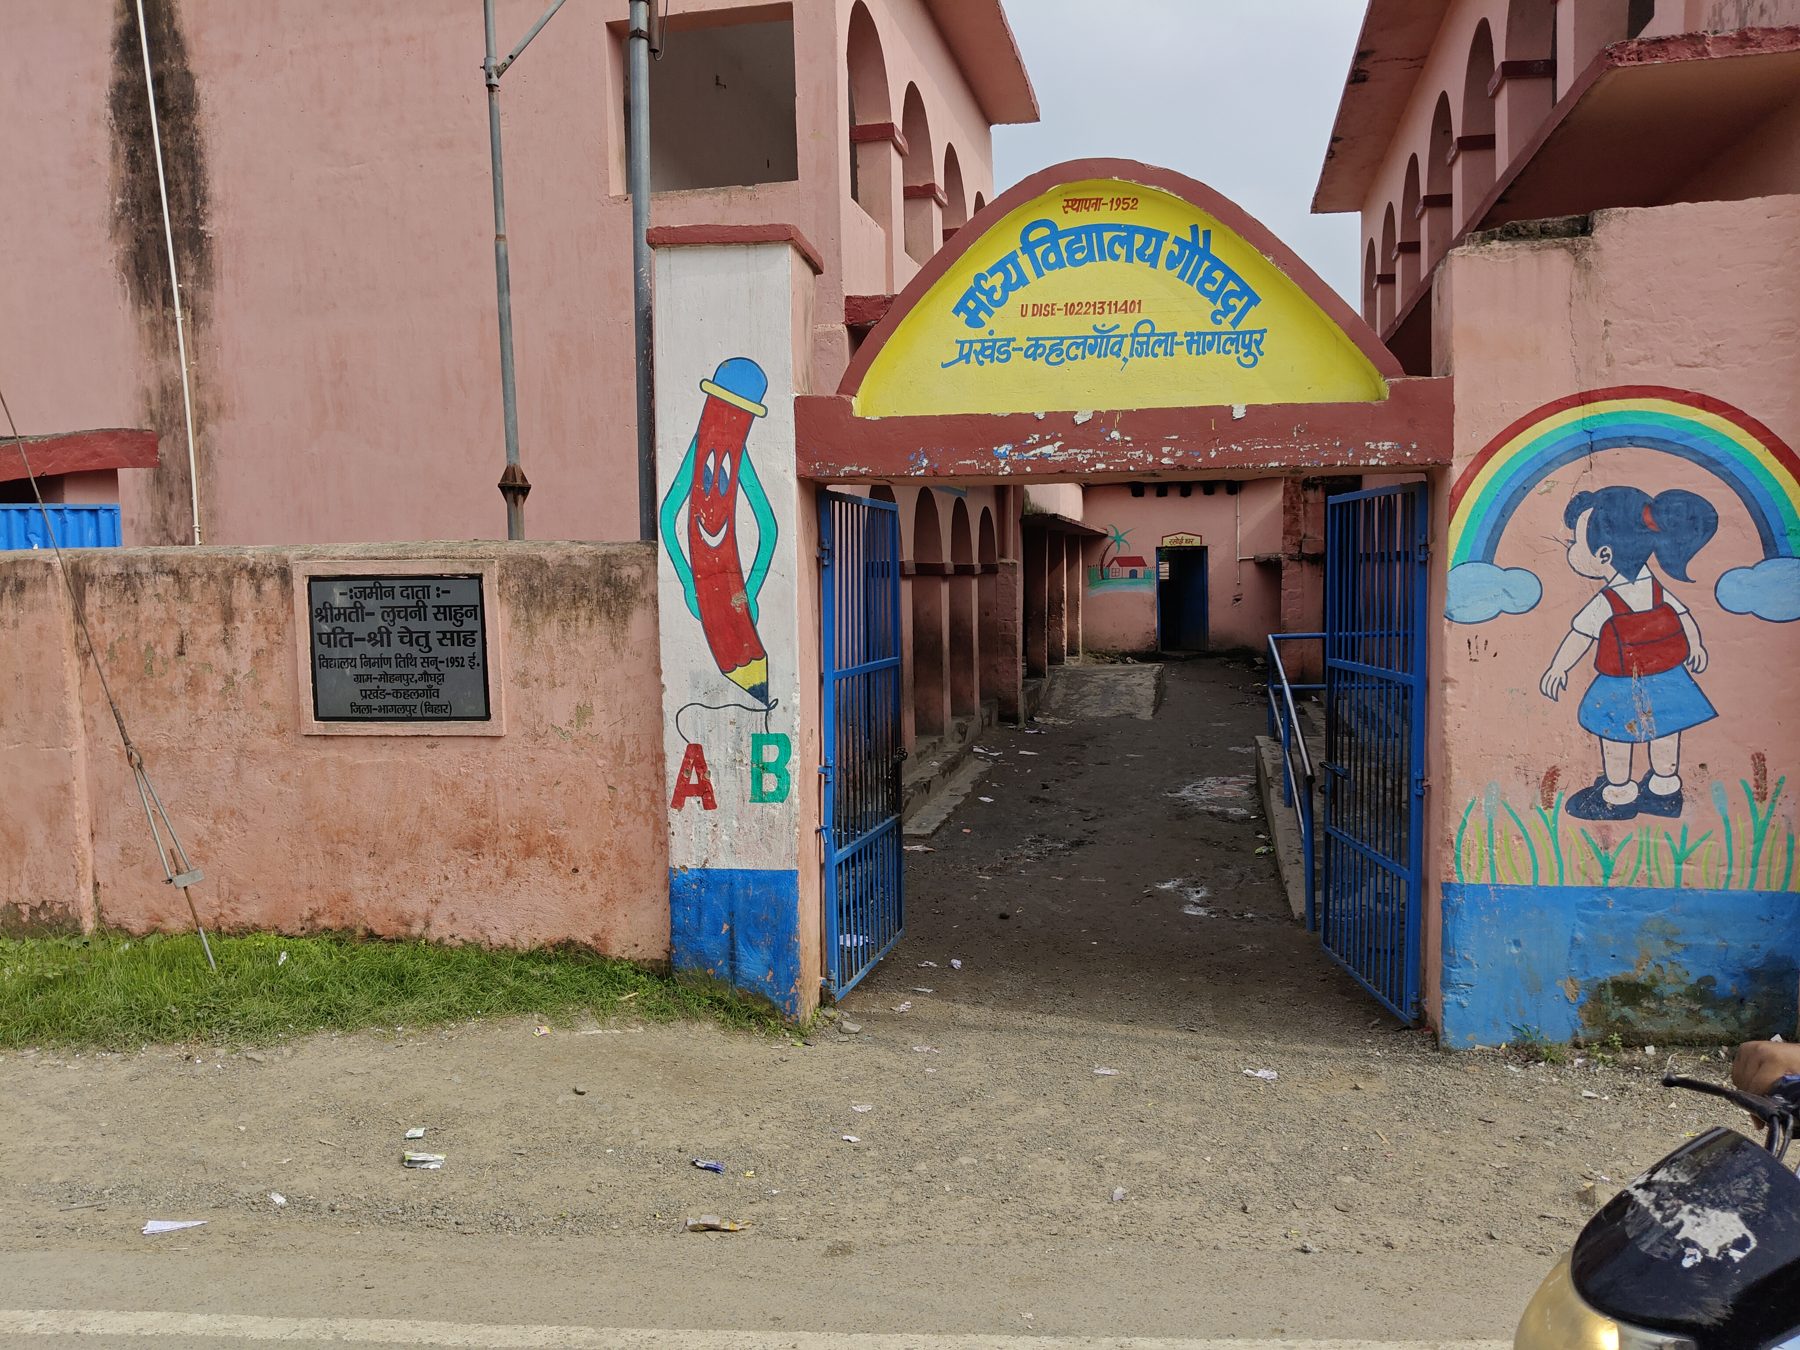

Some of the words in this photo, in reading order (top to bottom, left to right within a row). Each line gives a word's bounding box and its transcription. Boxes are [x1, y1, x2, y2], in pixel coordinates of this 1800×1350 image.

[1062, 197, 1139, 214] स्थापना-1952
[951, 248, 1029, 329] मध्य
[1020, 218, 1170, 279] विद्यालय
[399, 585, 431, 599] दाता
[380, 600, 428, 626] लुचनी
[431, 605, 478, 627] साहुन
[397, 626, 432, 653] चेतु
[436, 630, 478, 647] साह
[318, 654, 357, 669] विद्यालय
[360, 653, 392, 669] निर्माण
[395, 653, 417, 668] तिथि
[420, 701, 452, 717] (बिहार)
[670, 743, 718, 811] A
[749, 732, 792, 804] B
